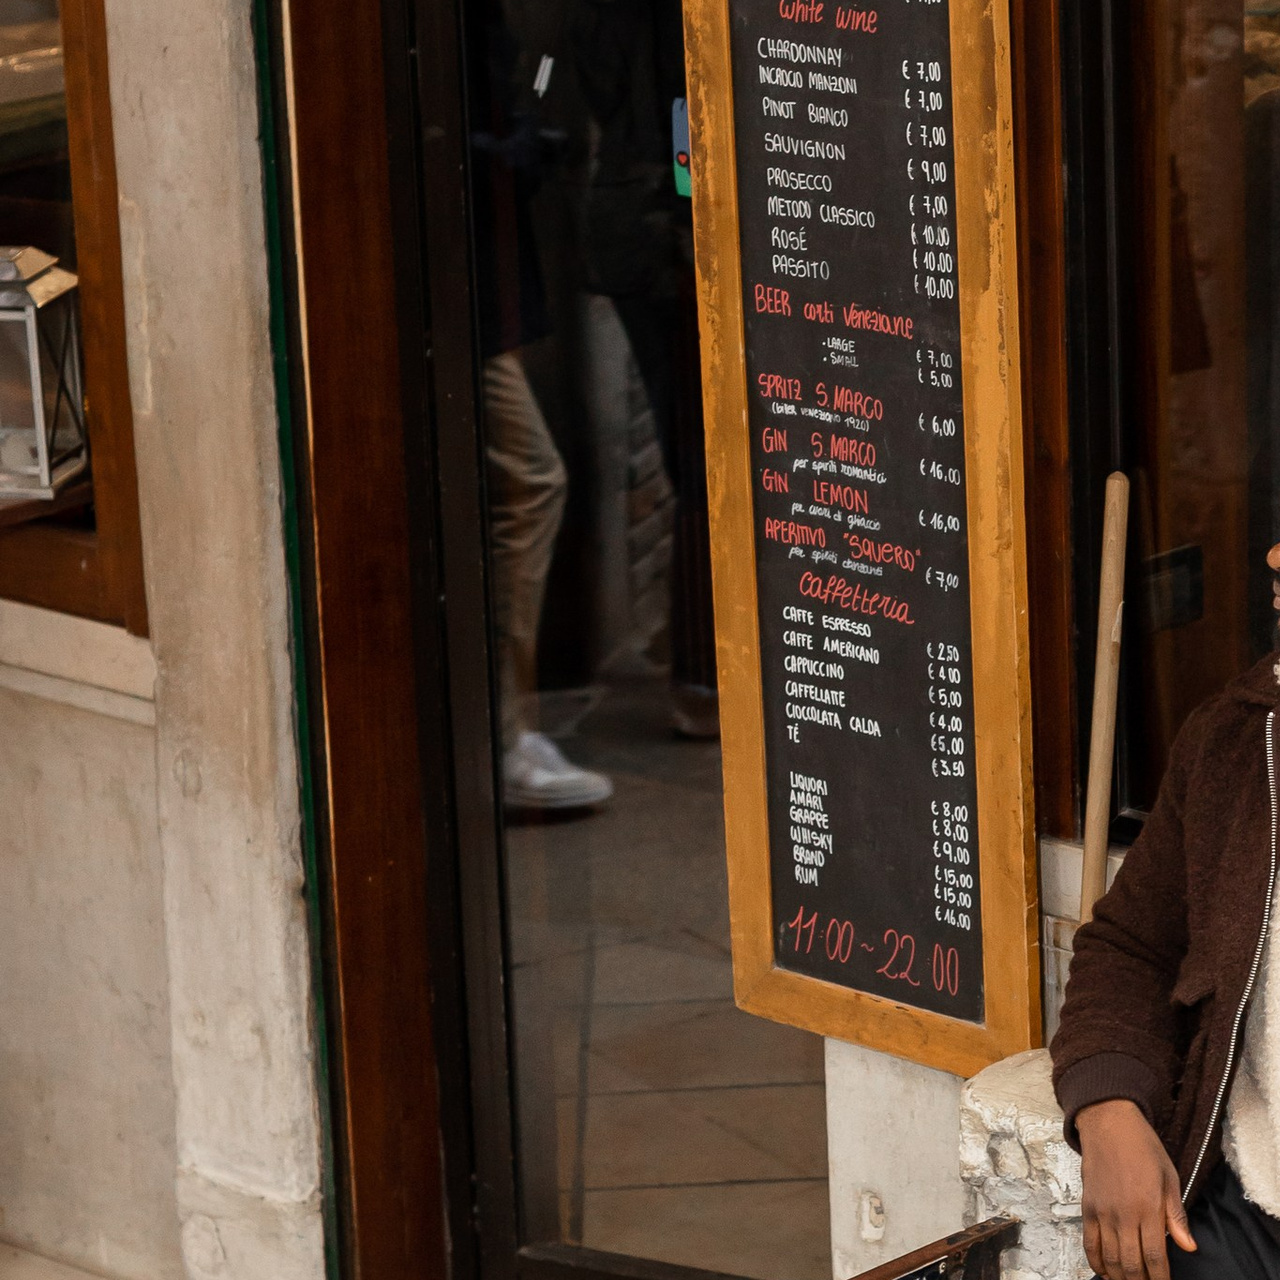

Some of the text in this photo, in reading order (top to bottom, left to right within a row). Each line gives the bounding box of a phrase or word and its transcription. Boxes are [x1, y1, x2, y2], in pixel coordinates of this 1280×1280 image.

[835, 6, 878, 34] wine
[757, 36, 842, 68] CHARDONNAY
[758, 65, 804, 89] INCROCIO
[808, 71, 858, 95] MANZONI
[762, 96, 797, 120] PINOT
[807, 102, 849, 128] BIANCO
[764, 132, 846, 161] SAUVIGNON
[766, 167, 832, 193] PROSECCO
[767, 195, 812, 220] METODO
[819, 203, 876, 229] CLASSICO
[771, 226, 808, 251] ROSÉ
[772, 254, 830, 280] PASSITO
[754, 283, 792, 317] BEER
[803, 300, 834, 324] corti
[827, 337, 856, 353] LARGE
[830, 351, 860, 368] SMALL
[757, 372, 803, 401] SPRITZ
[833, 384, 884, 421] MARCO
[844, 416, 871, 433] 1920)
[762, 426, 788, 454] GIN
[830, 433, 877, 467] MARCO
[792, 457, 809, 472] per
[762, 468, 869, 515] GIN LEMON
[791, 502, 806, 516] per
[764, 516, 826, 549] APERITIVO
[788, 546, 806, 560] per
[782, 605, 815, 626] CAFFE
[821, 614, 872, 638] ESPRESSO
[782, 630, 880, 665] CAFFE AMERICANO
[783, 654, 845, 681] CAPPUCCINO
[784, 679, 846, 708] CAFFELLATTE
[785, 701, 843, 731] CIOCCOLATA
[849, 715, 882, 738] CALDA
[789, 771, 828, 796] LIQUORI
[789, 788, 824, 811] AMARI
[789, 805, 829, 830] GRAPPE
[790, 825, 833, 855] WHISKY
[793, 844, 825, 868] BRAND
[794, 863, 819, 887] RUM
